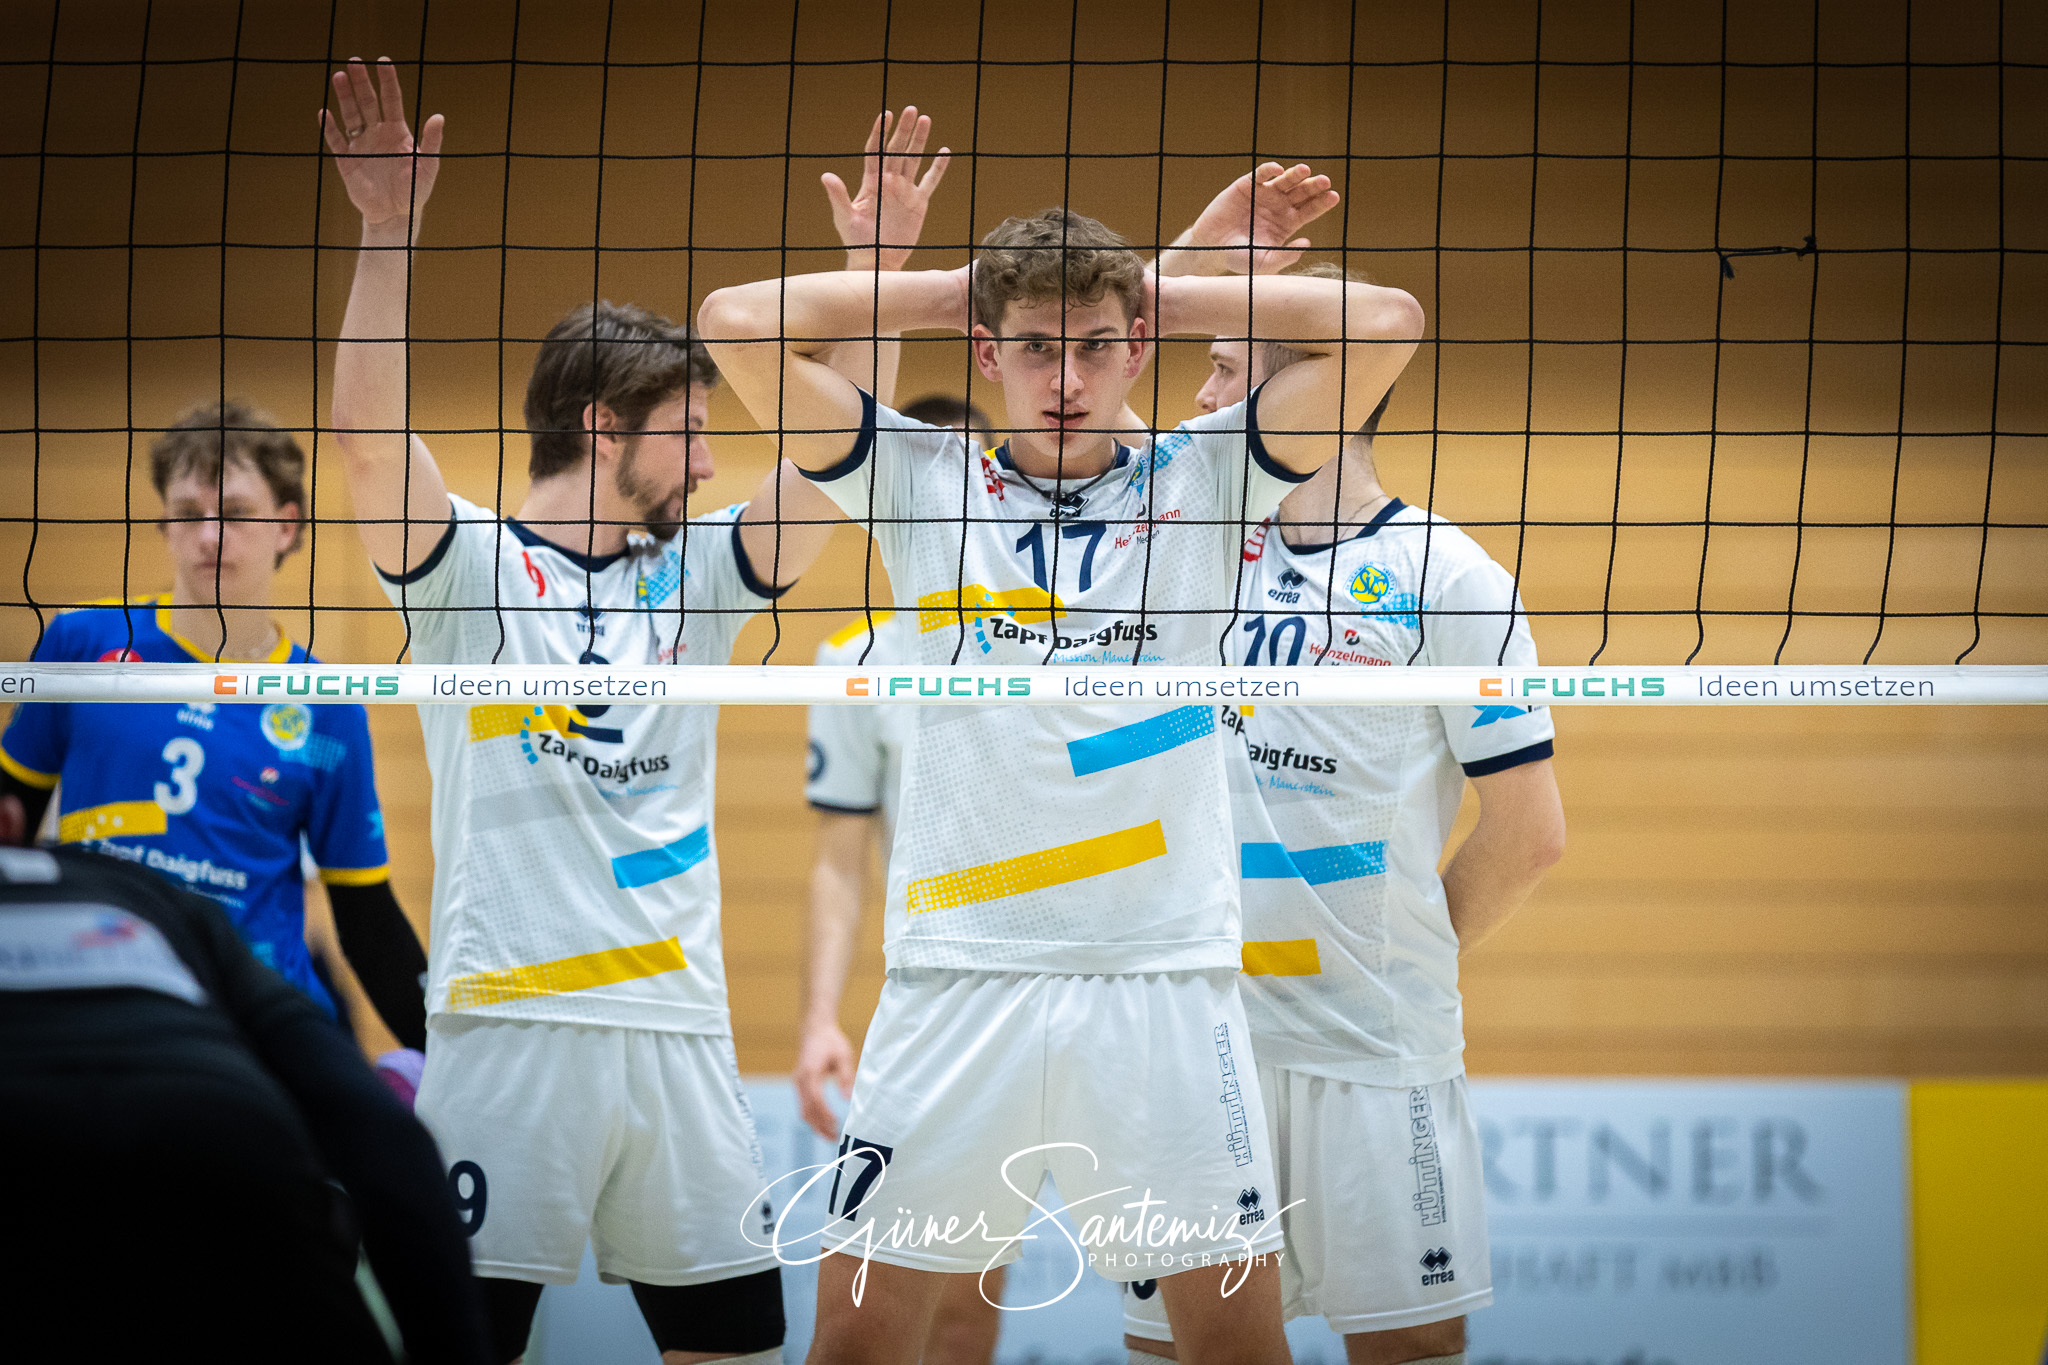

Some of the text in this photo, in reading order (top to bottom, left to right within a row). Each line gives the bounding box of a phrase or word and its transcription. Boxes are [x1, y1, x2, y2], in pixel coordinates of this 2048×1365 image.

[1015, 521, 1107, 594] 17
[1267, 586, 1301, 605] errea
[1054, 619, 1158, 650] Daigfuss
[1243, 614, 1307, 666] 10
[1309, 642, 1392, 666] Henzelmann
[257, 675, 399, 696] FUCHS
[433, 673, 510, 696] Ideen
[523, 674, 666, 696] umsetzen
[889, 676, 1031, 697] FUCHS
[1065, 674, 1143, 697] Ideen
[1156, 675, 1299, 697] umsetzen
[1522, 677, 1665, 697] FUCHS
[1699, 674, 1778, 697] Ideen
[1790, 675, 1934, 697] umsetzen
[583, 753, 670, 784] Daigfuss
[1248, 741, 1339, 775] aigfuss
[153, 736, 206, 816] 3
[447, 1160, 488, 1239] 9
[1420, 1269, 1456, 1287] errea
